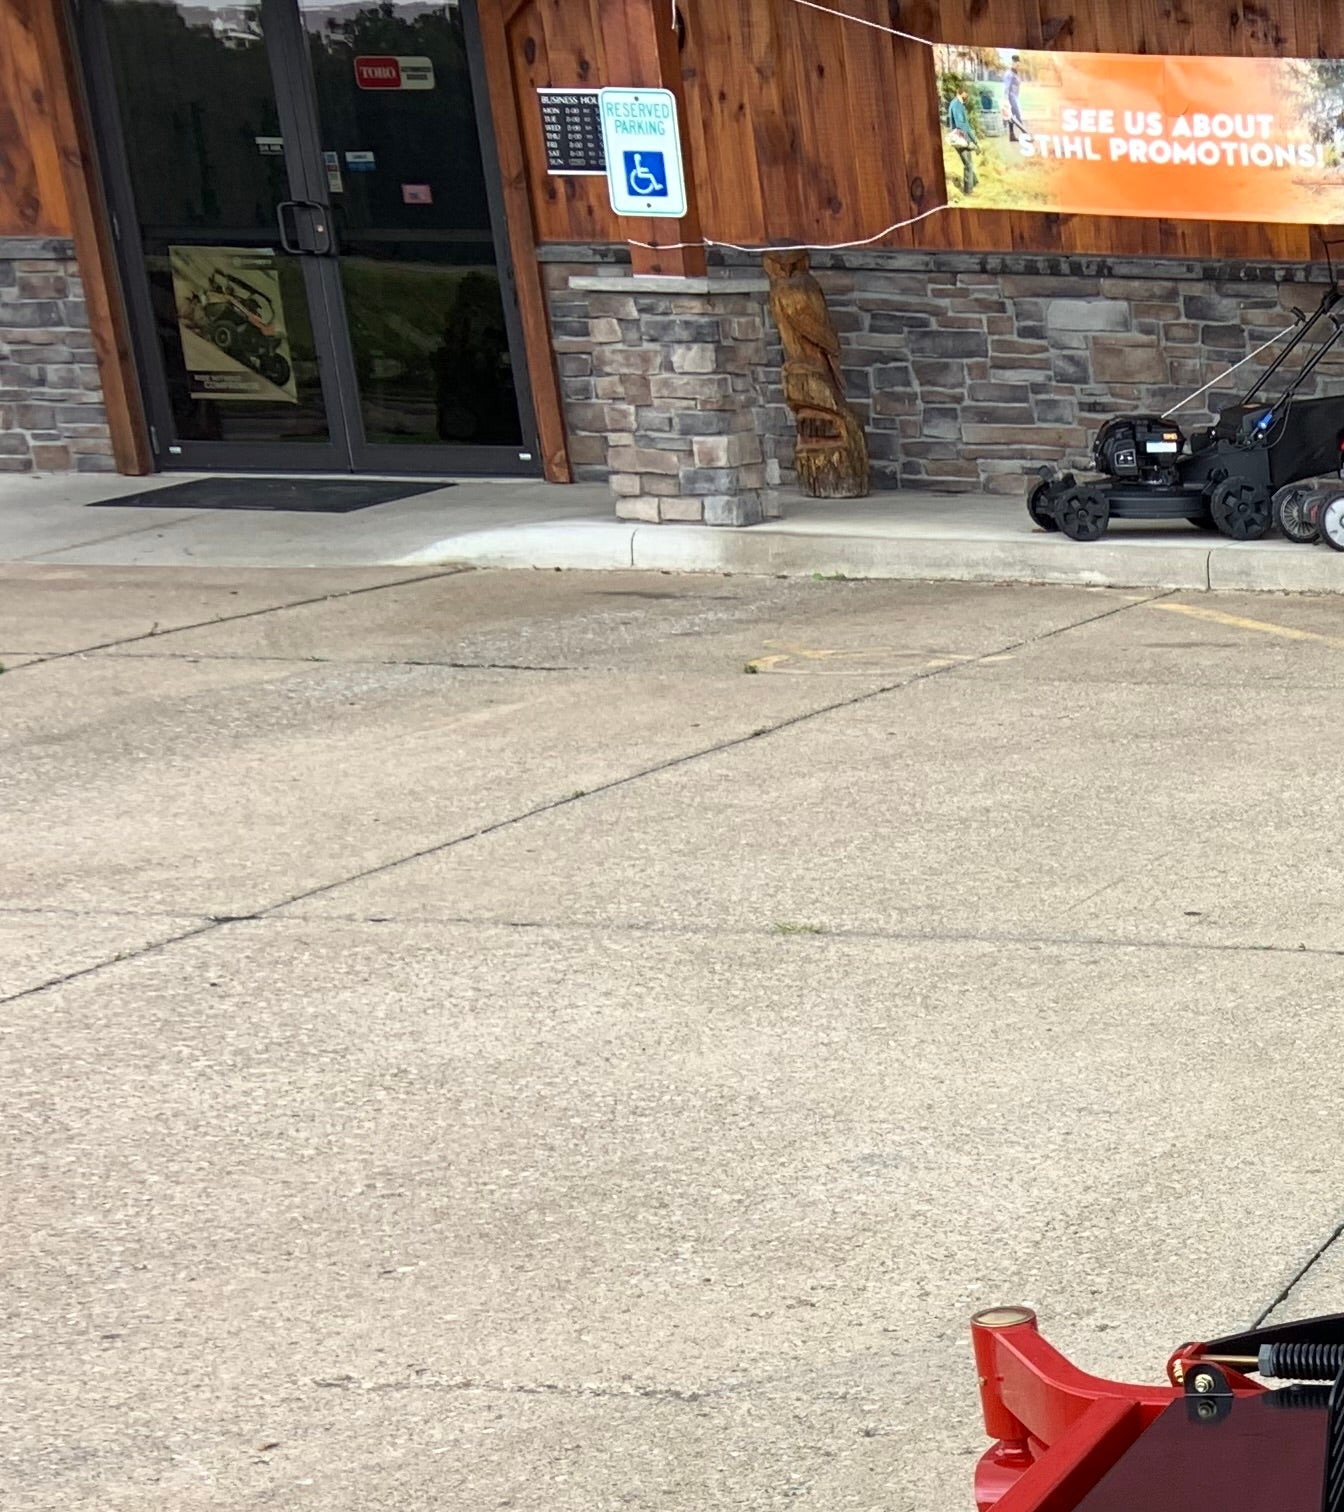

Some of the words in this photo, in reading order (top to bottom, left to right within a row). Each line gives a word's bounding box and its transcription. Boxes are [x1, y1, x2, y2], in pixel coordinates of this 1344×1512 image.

[360, 66, 397, 79] TORO
[540, 95, 578, 105] BUSINESS
[580, 96, 599, 105] HOU
[606, 102, 670, 119] RESERVED
[615, 119, 665, 136] PARKING
[1061, 108, 1113, 135] SEE
[1124, 111, 1163, 136] US
[1171, 112, 1275, 139] ABOUT
[1018, 134, 1101, 161] STIHL
[1110, 137, 1324, 168] PROMOTIONS!
